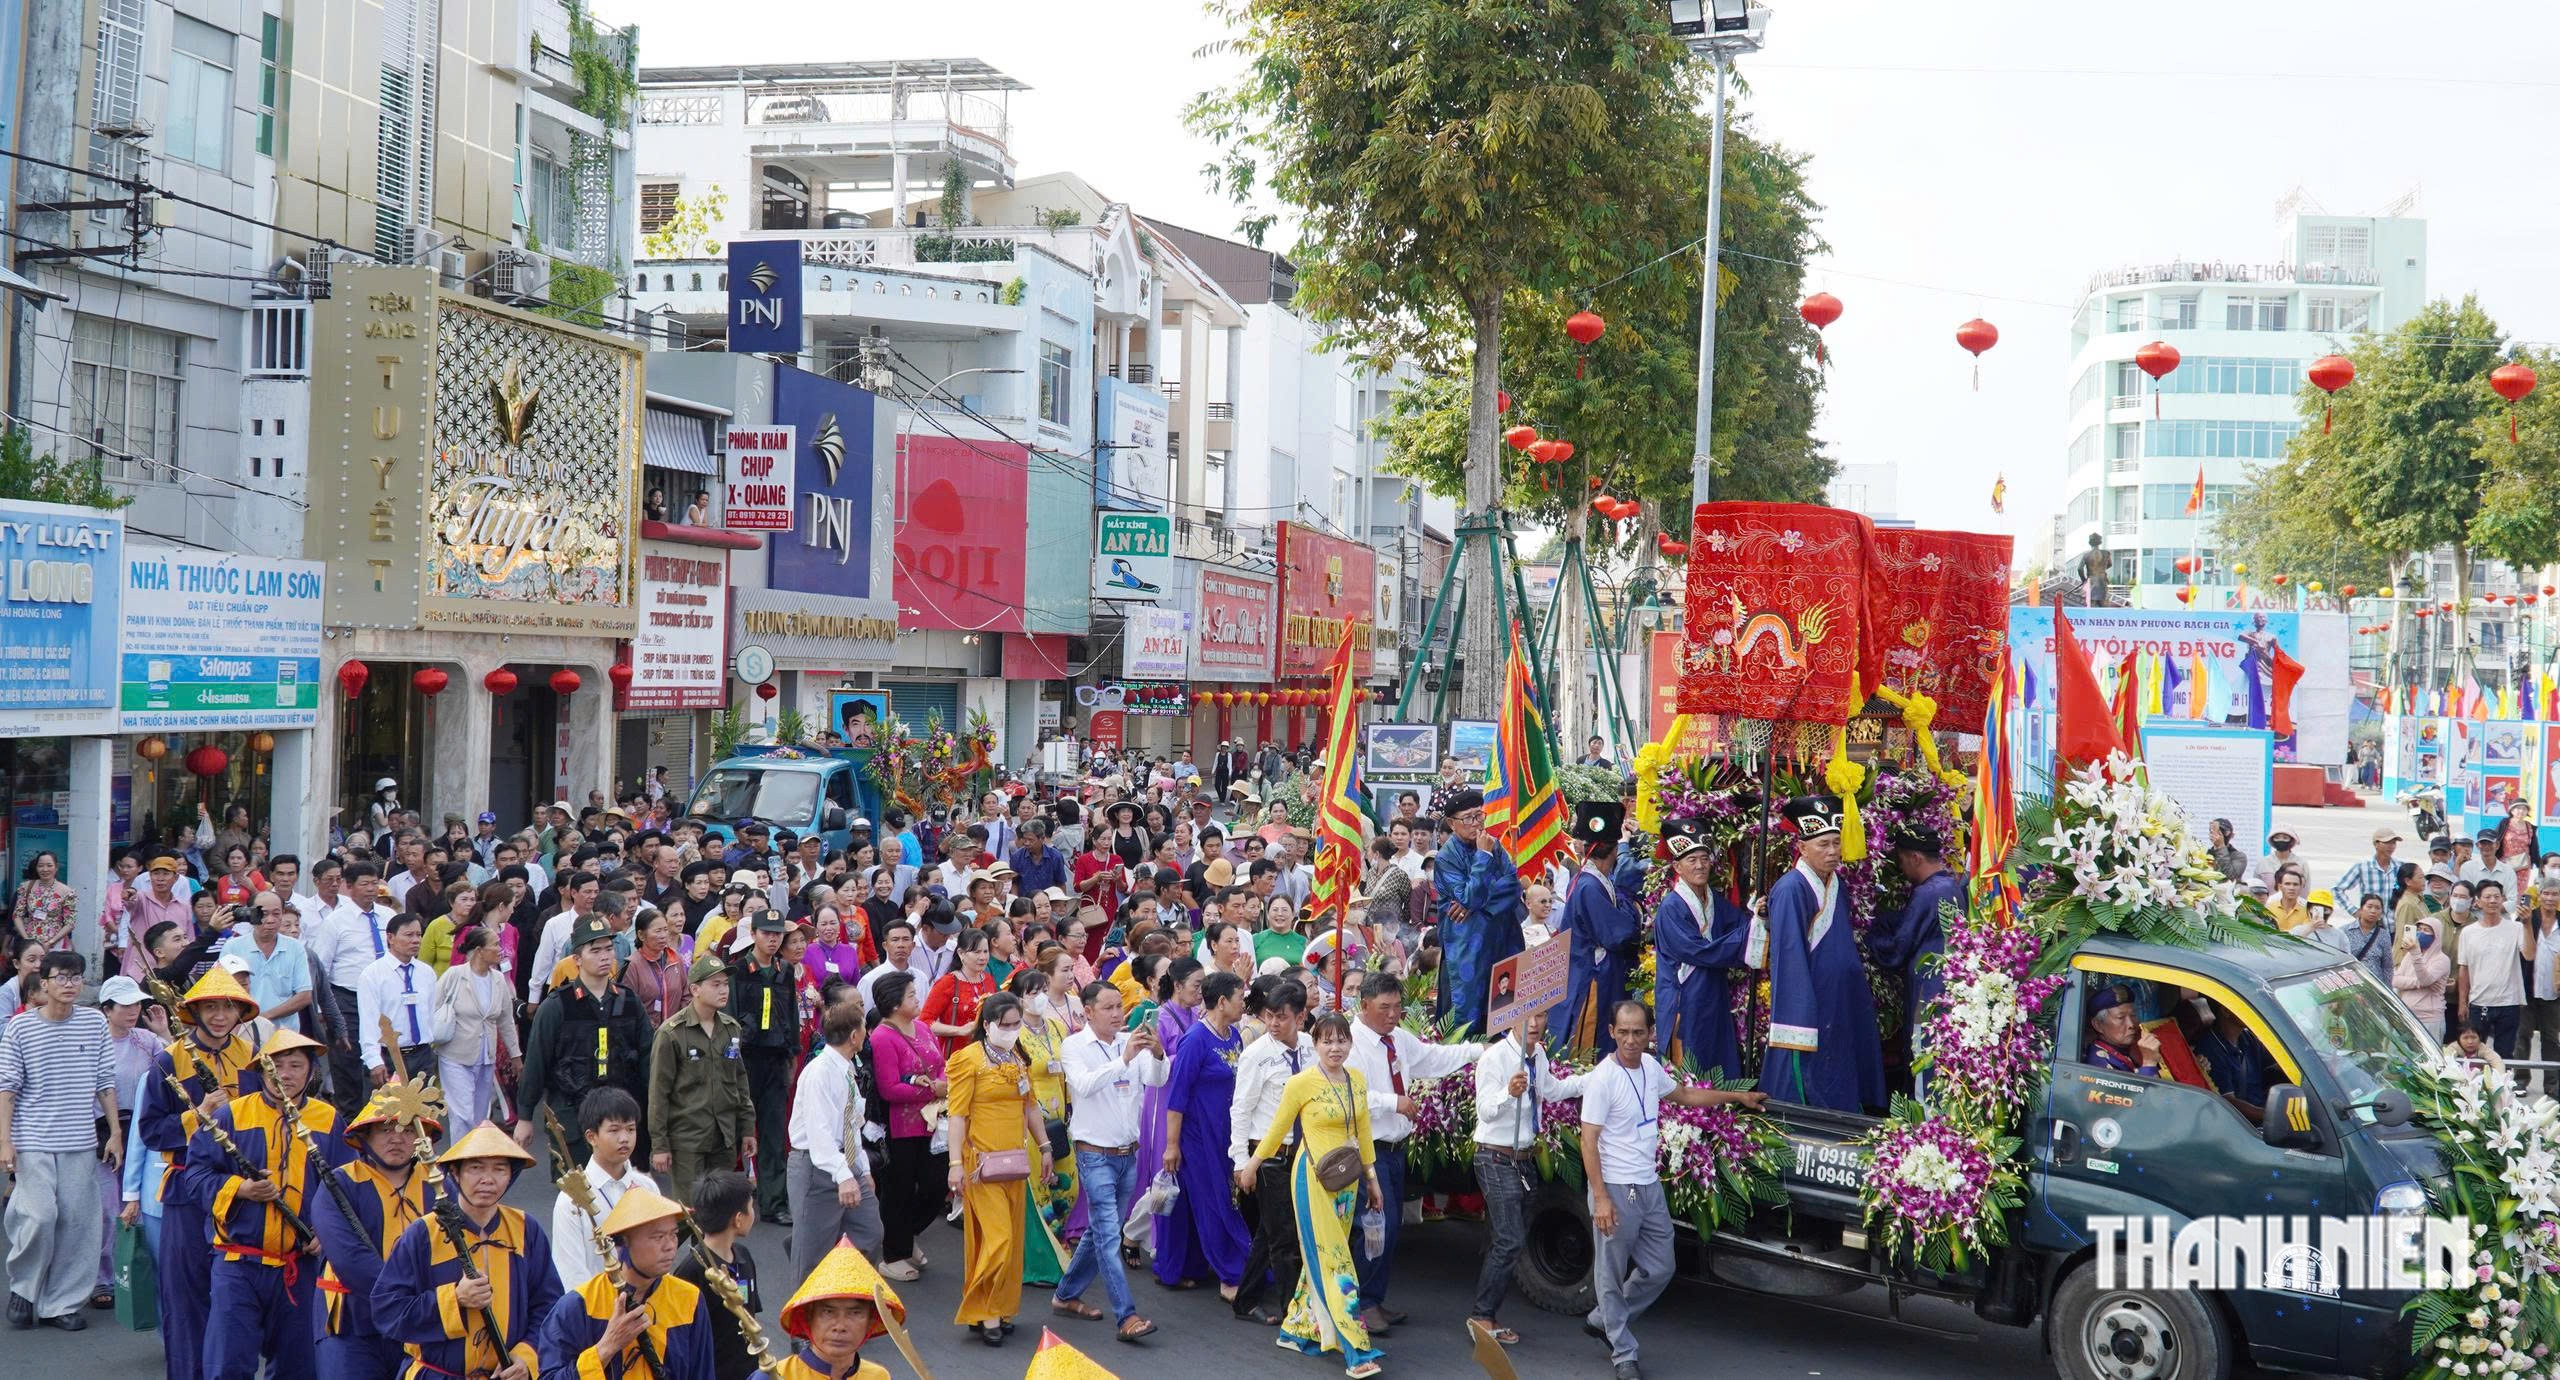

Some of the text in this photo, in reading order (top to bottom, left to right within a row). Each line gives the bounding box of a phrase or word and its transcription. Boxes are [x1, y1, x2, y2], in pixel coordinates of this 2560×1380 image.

[2254, 260, 2298, 282] THÔN
[368, 289, 415, 316] TIỆM
[740, 297, 783, 331] PNJ
[364, 319, 417, 339] VÀNG
[728, 428, 788, 450] PHÒNG KHÁM
[367, 355, 404, 593] TUYẾT
[741, 456, 774, 481] CHỤP
[744, 484, 786, 507] QUANG
[777, 512, 787, 520] 25
[37, 522, 114, 555] LUẬT
[809, 491, 853, 566] PNJ
[1104, 529, 1167, 553] AN TÀI
[9, 559, 94, 604] LONG
[130, 555, 322, 600] NHÀ THUỐC LAM SƠN
[893, 543, 1001, 601] DOJI
[41, 609, 62, 619] LONG
[744, 609, 794, 635] TRUNG
[793, 607, 821, 637] TÂM
[821, 615, 845, 639] KIM
[845, 613, 880, 640] HOÀN
[1143, 636, 1161, 654] AN
[199, 657, 252, 681] Salonpas
[197, 688, 252, 705] Hisamitsu
[140, 713, 162, 727] THUỐC
[254, 713, 286, 725] HISAMITSU
[302, 713, 315, 724] NAM
[1098, 741, 1117, 751] AN
[2095, 1078, 2145, 1094] FRONTIER
